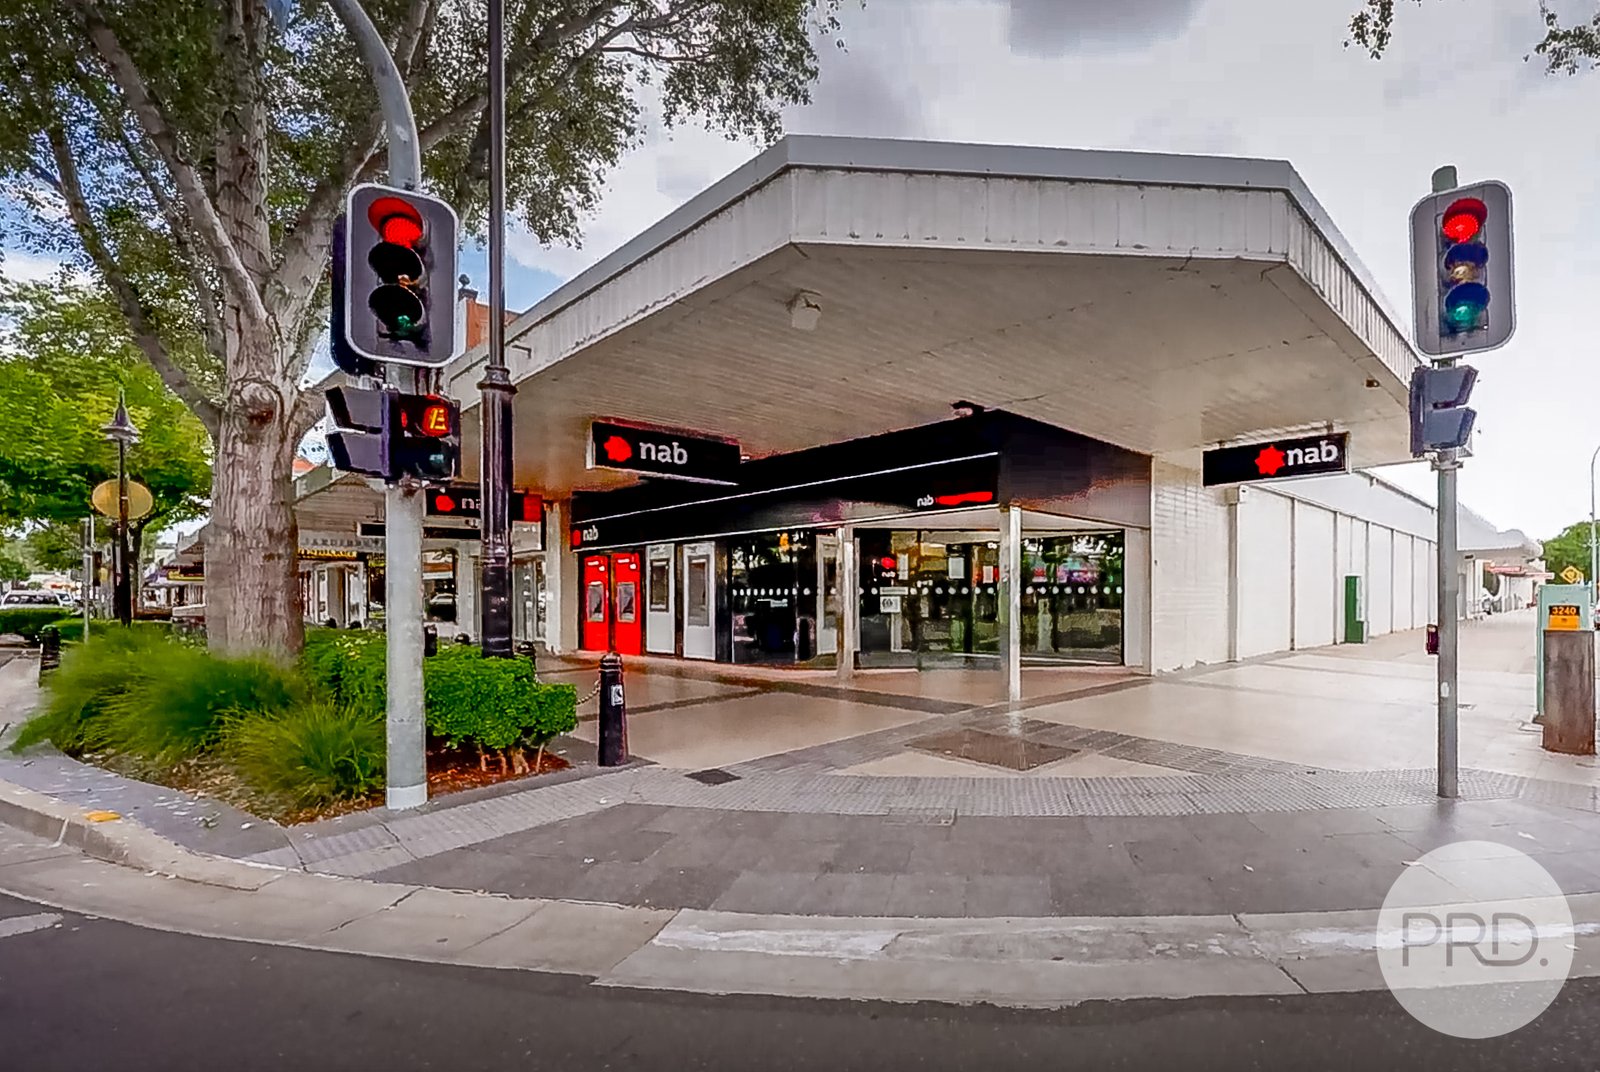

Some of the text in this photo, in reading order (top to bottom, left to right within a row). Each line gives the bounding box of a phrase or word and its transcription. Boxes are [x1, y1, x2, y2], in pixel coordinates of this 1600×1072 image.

[639, 442, 688, 465] nab
[1286, 440, 1339, 466] nab
[917, 493, 935, 508] nab
[582, 524, 599, 542] nab
[1551, 606, 1577, 616] 3240
